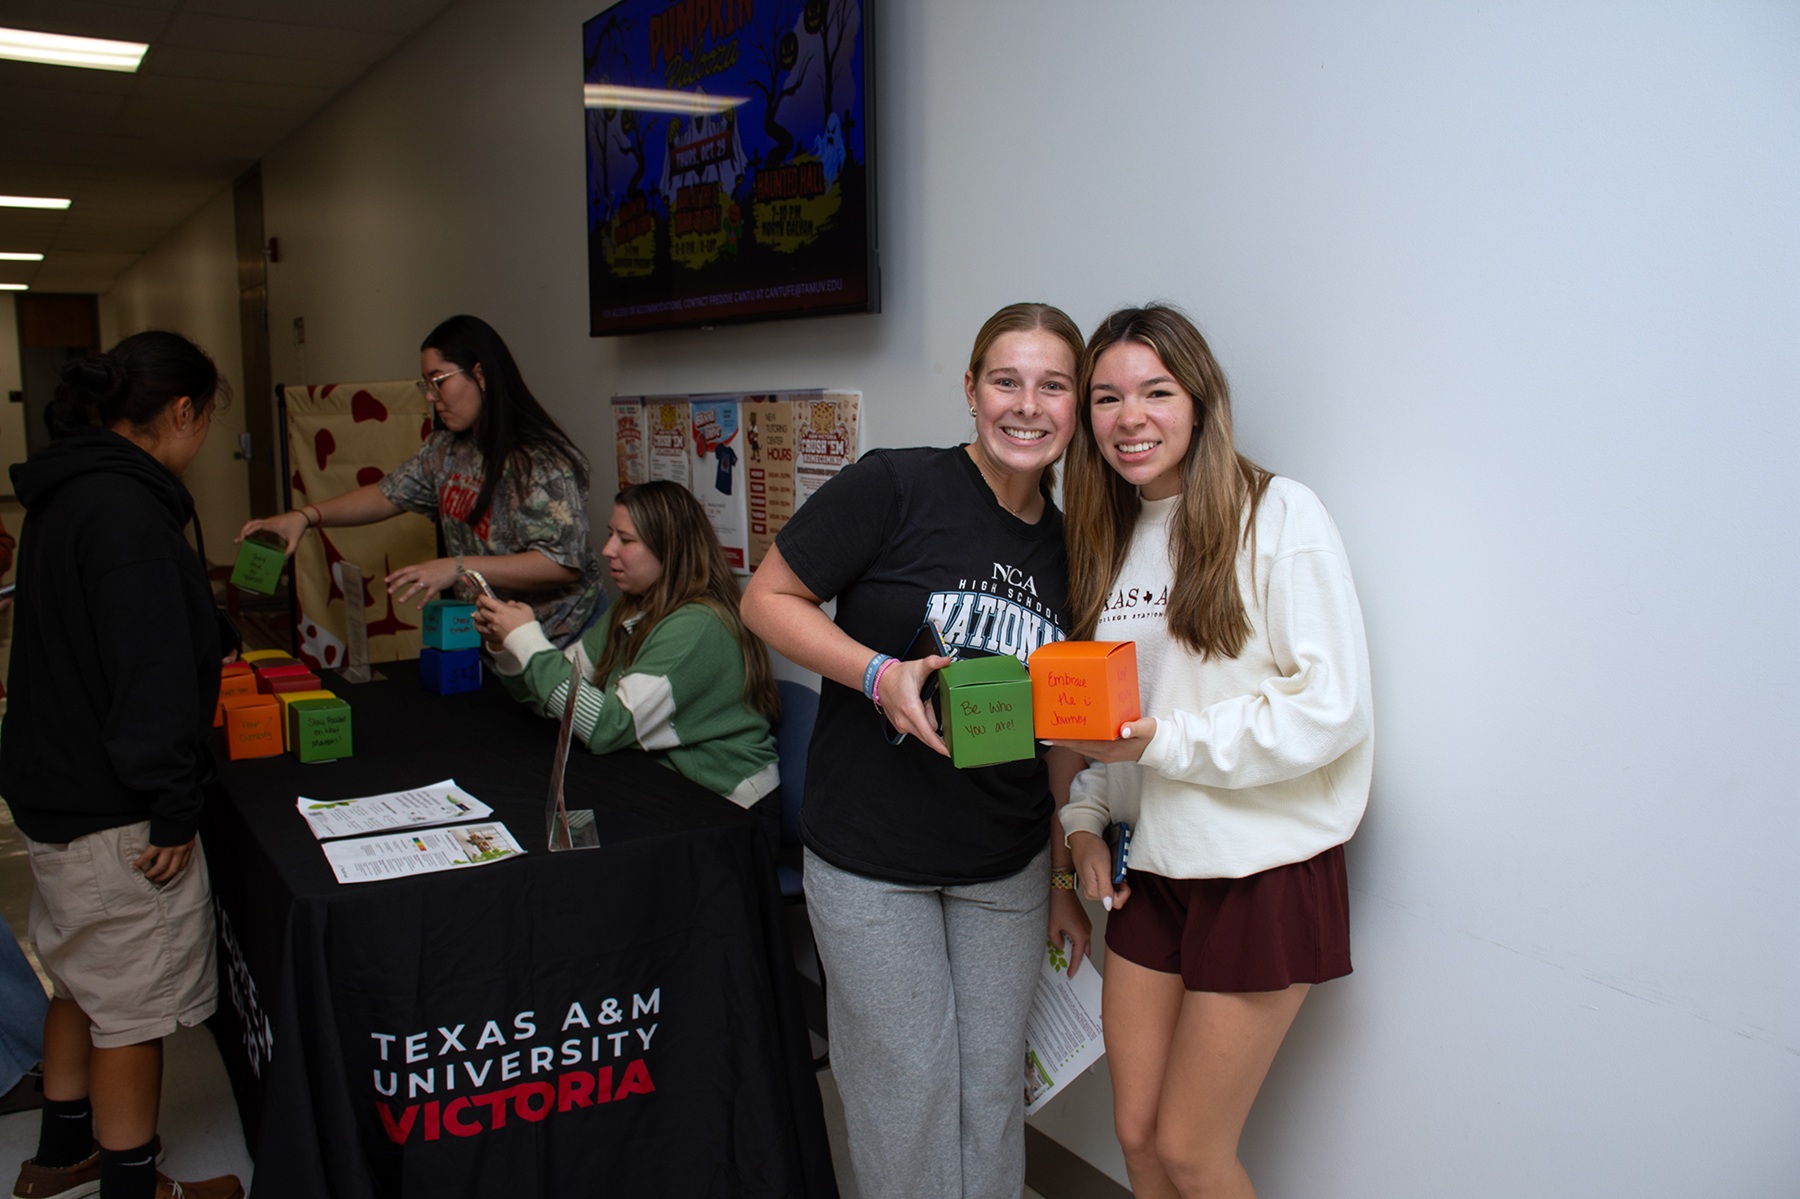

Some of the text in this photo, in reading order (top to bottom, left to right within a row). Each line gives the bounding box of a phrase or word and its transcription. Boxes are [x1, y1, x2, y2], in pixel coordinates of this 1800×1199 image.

[800, 162, 824, 197] HALL
[756, 288, 765, 301] AT
[767, 447, 793, 461] HOURS
[801, 438, 827, 454] CRUSH
[991, 562, 1038, 598] NCA
[959, 579, 1059, 625] HIGH SCHOOL
[961, 700, 981, 716] Be
[1058, 692, 1076, 706] the
[995, 719, 1016, 733] are!
[371, 987, 660, 1064] TEXAS A&M
[373, 1023, 659, 1099] UNIVERSITY
[375, 1059, 656, 1145] VICTORIA
